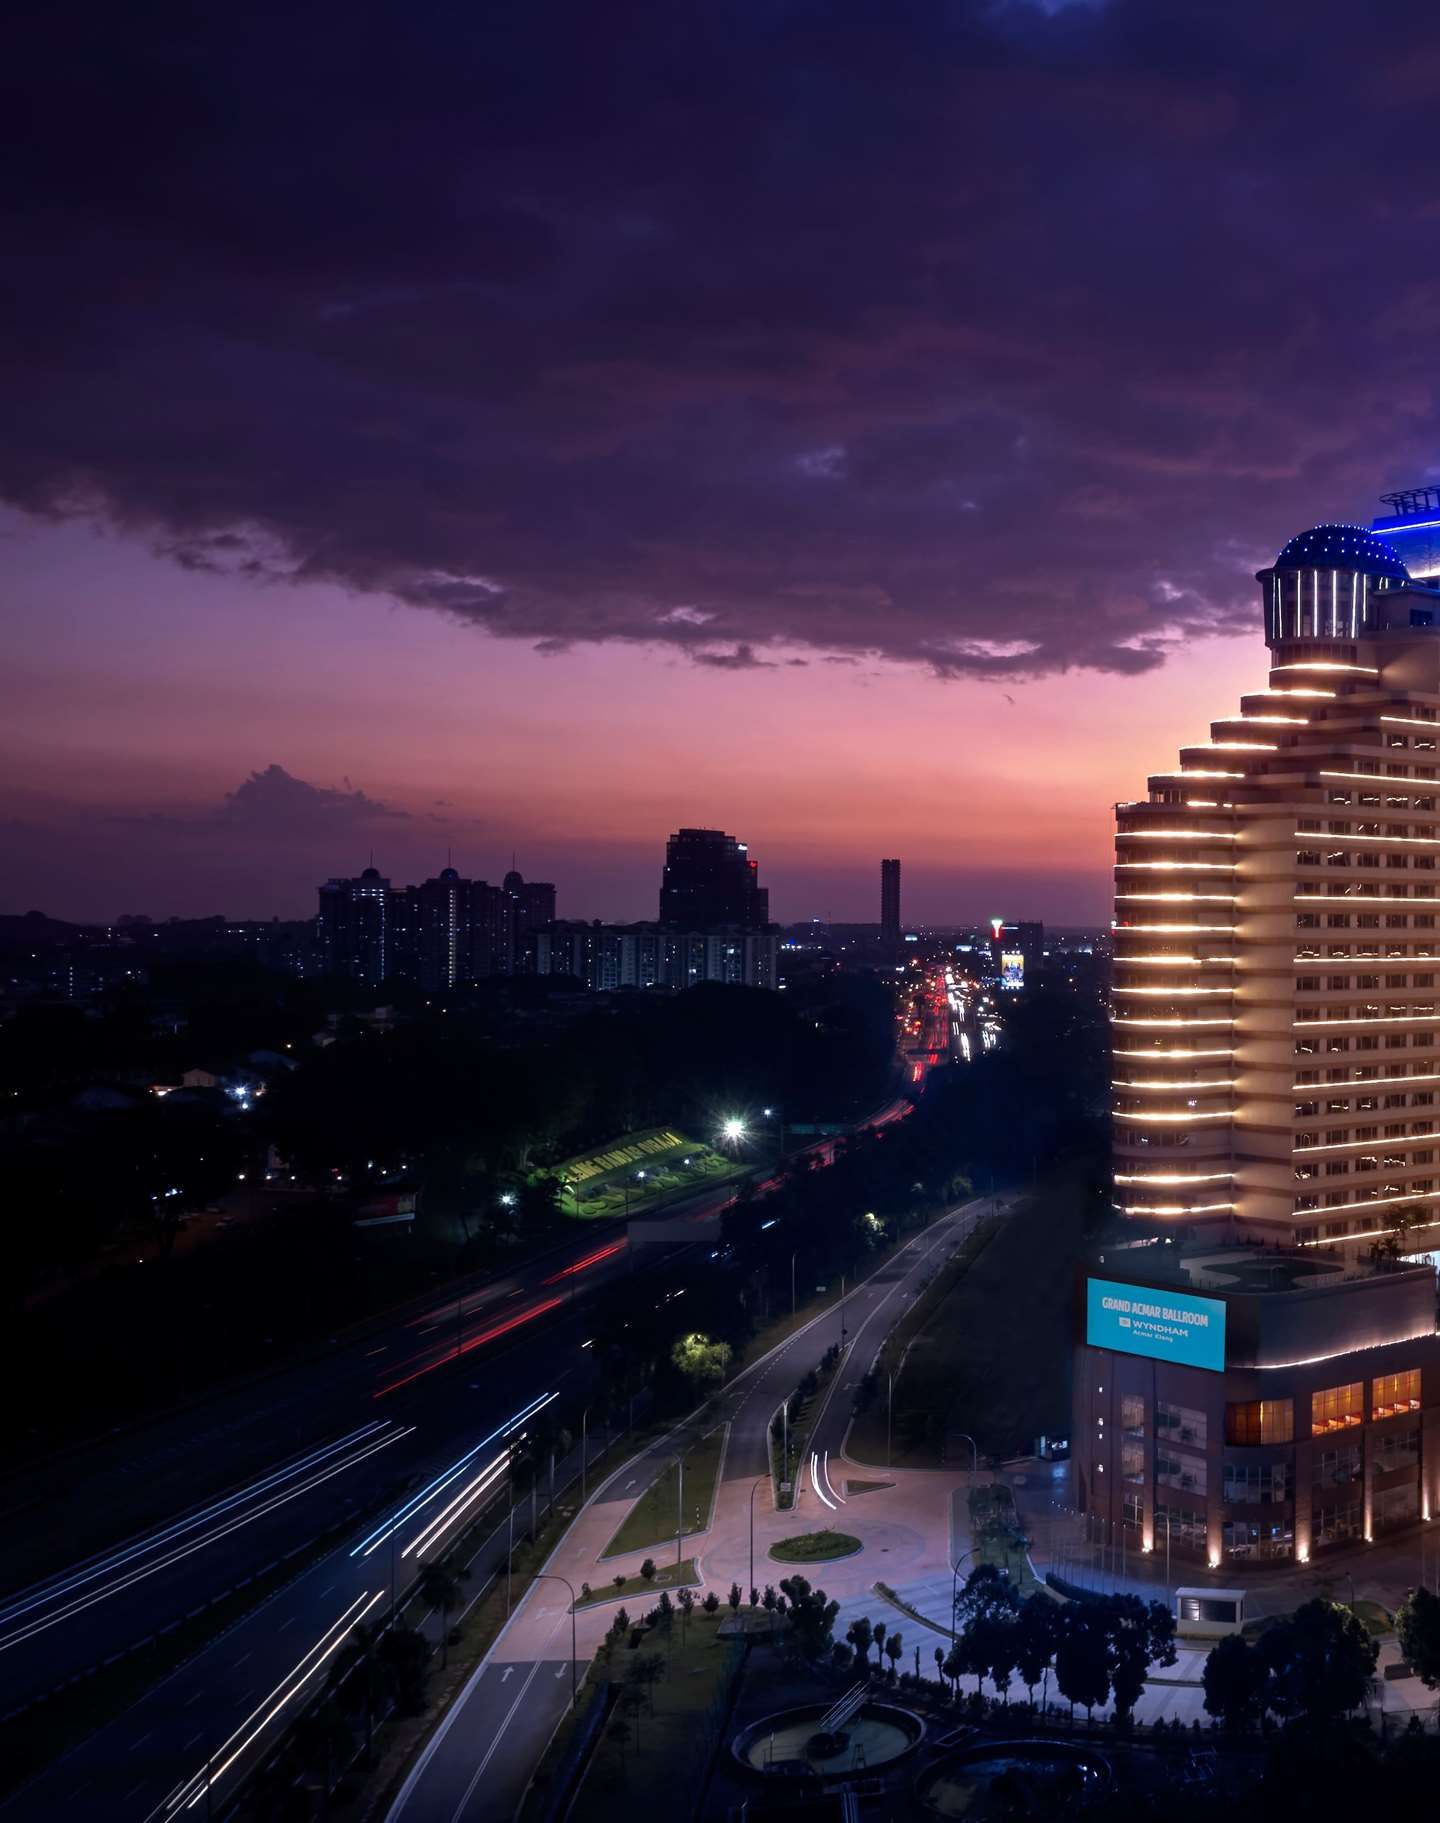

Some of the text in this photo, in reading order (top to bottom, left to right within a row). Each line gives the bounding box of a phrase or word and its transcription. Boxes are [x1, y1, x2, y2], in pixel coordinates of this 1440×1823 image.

[1102, 1297, 1209, 1328] GRAND ACMAR BALLROOM
[1132, 1320, 1189, 1337] WYNDHAM
